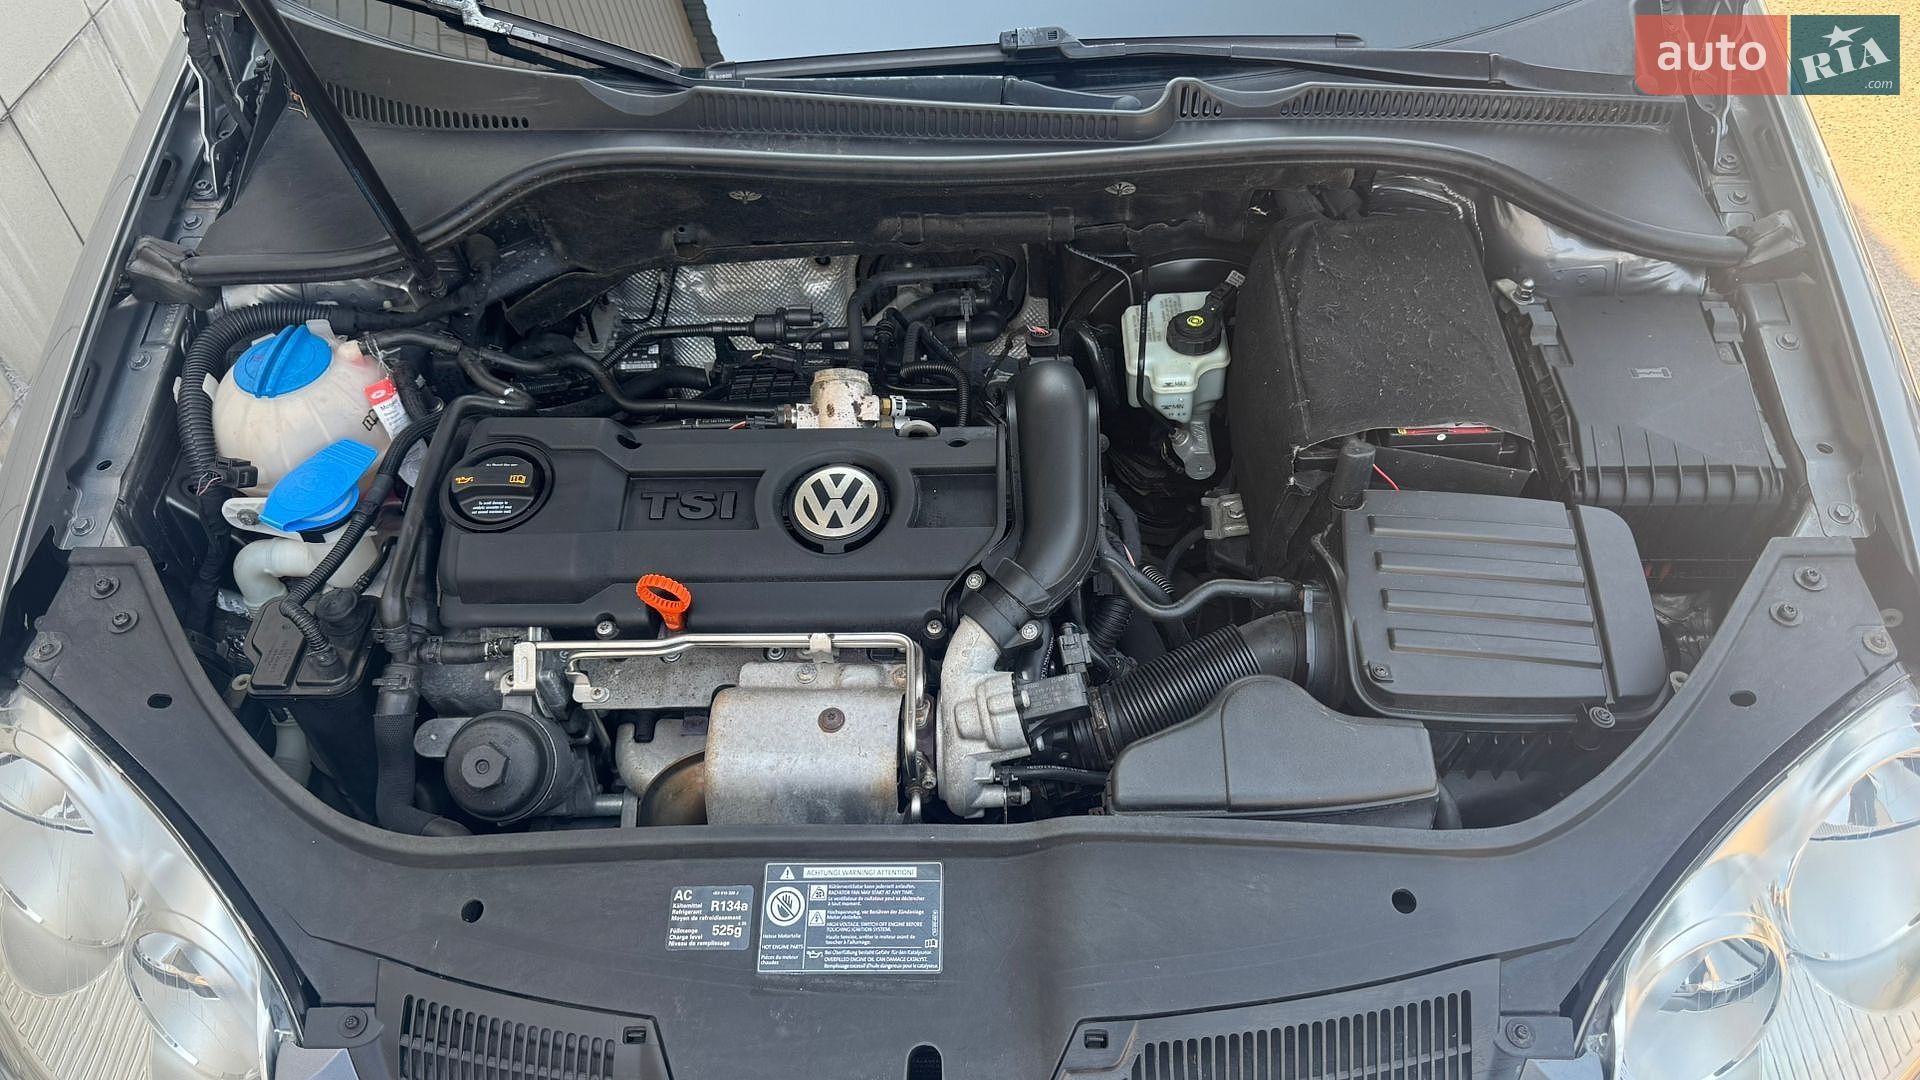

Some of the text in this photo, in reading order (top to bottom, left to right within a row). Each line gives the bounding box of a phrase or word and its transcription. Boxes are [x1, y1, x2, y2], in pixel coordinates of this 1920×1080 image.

[640, 490, 738, 520] TSI
[794, 465, 878, 537] VW
[674, 890, 692, 901] AC
[710, 900, 748, 912] R134a
[712, 924, 742, 938] 525g
